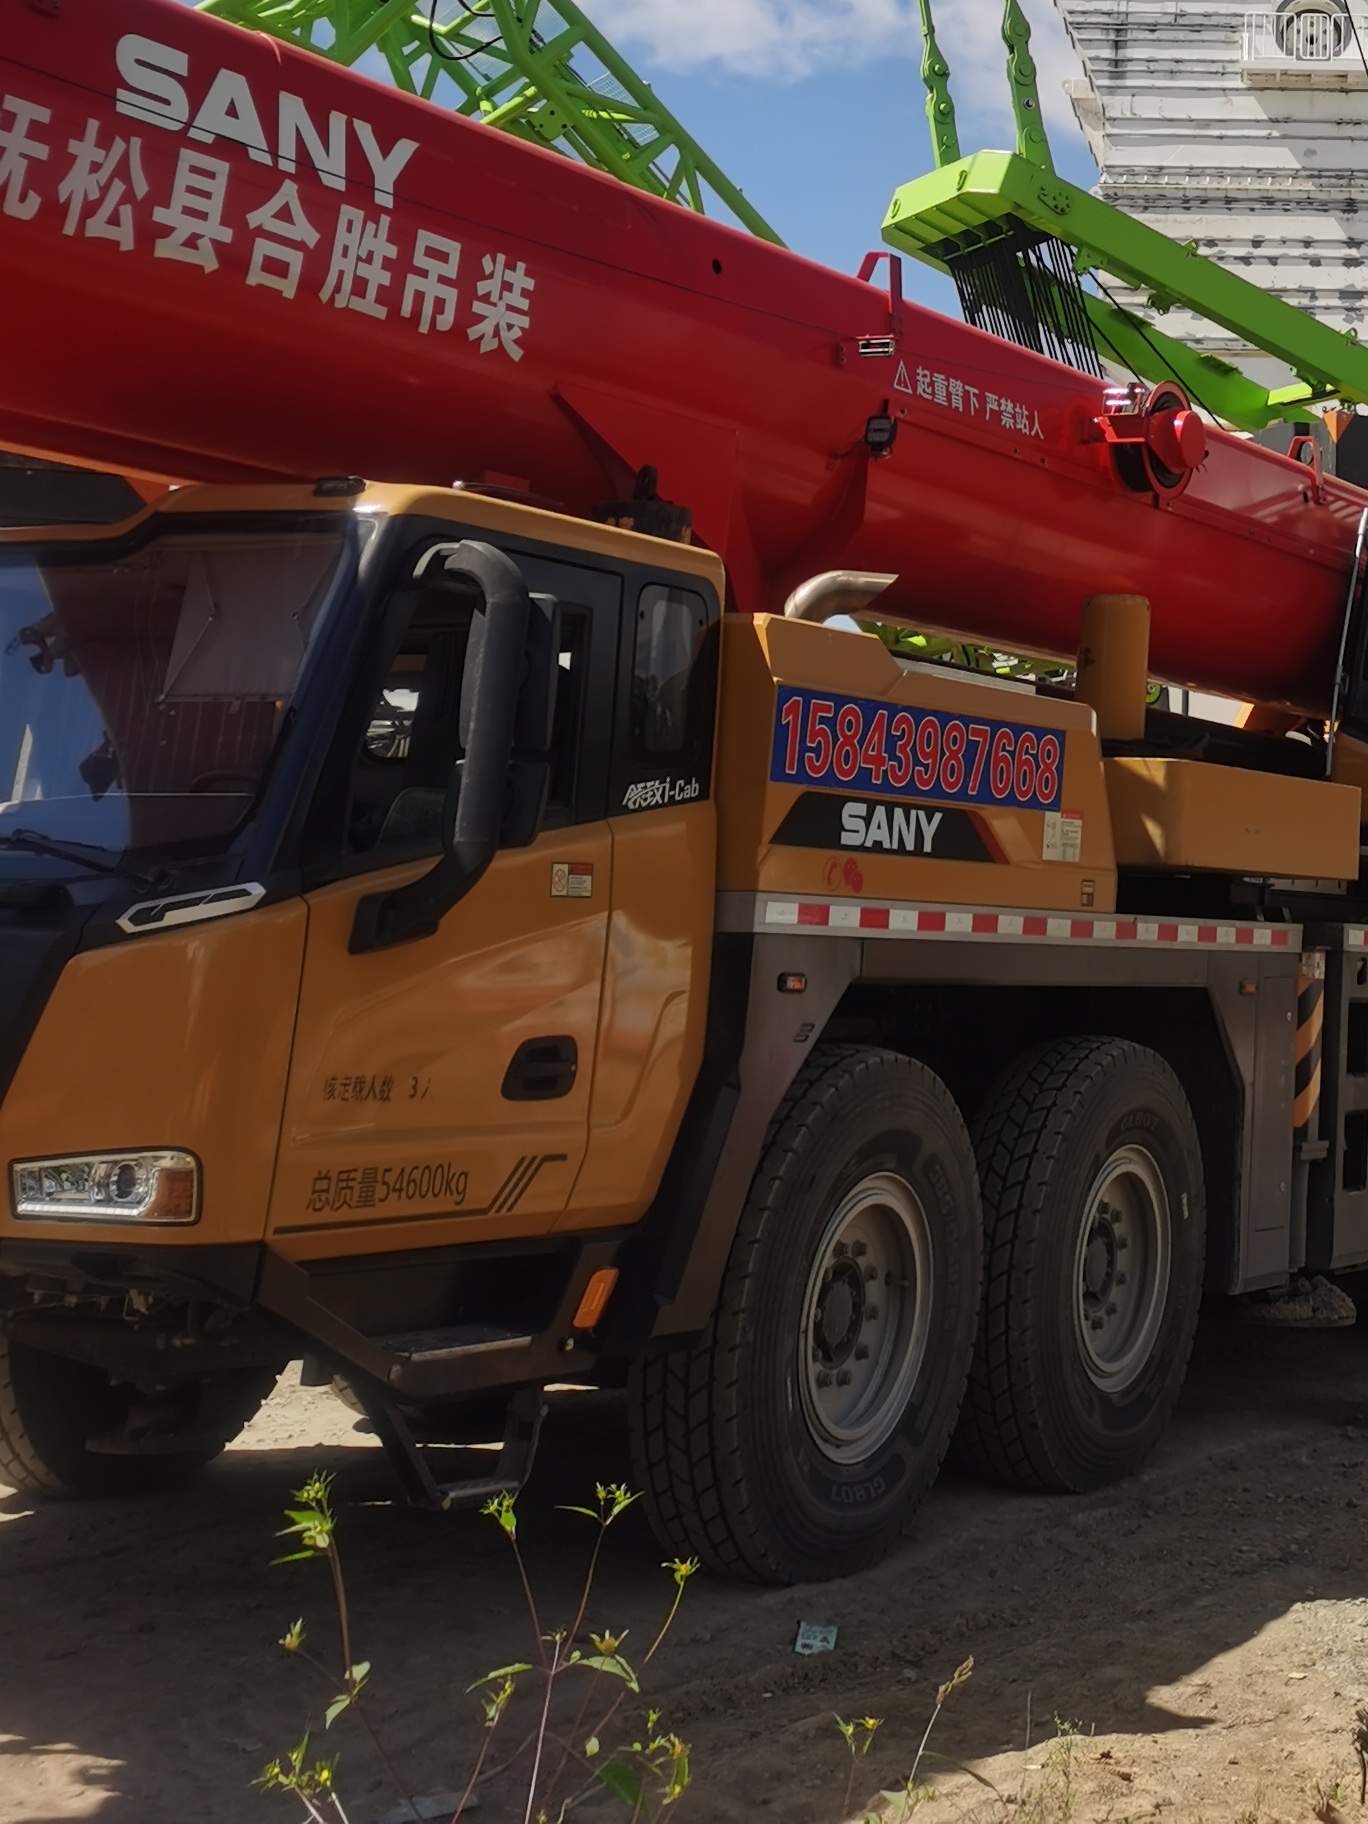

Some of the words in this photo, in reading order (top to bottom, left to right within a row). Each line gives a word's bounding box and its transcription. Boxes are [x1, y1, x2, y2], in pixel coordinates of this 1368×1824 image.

[115, 33, 420, 209] SANY
[916, 365, 980, 416] 起重臂下
[985, 391, 1044, 440] 严禁站人
[782, 697, 1060, 803] 15843987668
[840, 802, 943, 853] SANY
[305, 1161, 469, 1212] 总质量54600kg
